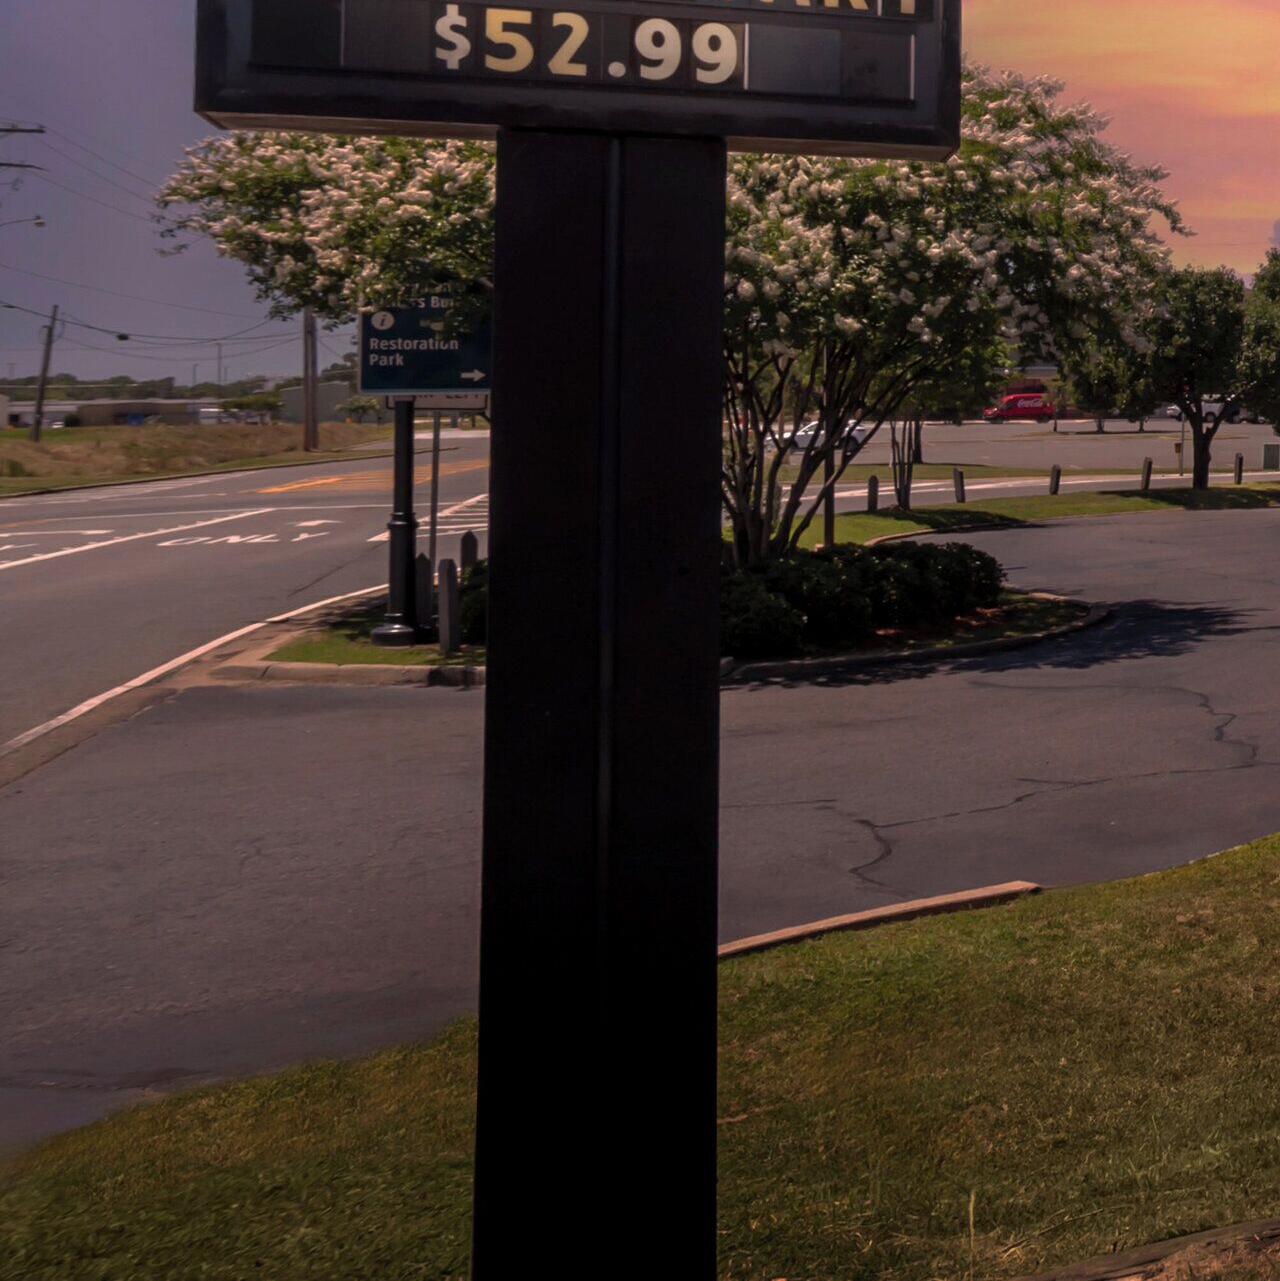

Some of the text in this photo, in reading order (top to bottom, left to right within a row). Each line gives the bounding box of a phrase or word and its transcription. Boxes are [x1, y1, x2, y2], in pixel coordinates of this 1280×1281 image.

[434, 3, 739, 85] $52.99
[369, 337, 459, 350] Restoration
[369, 353, 404, 366] Park
